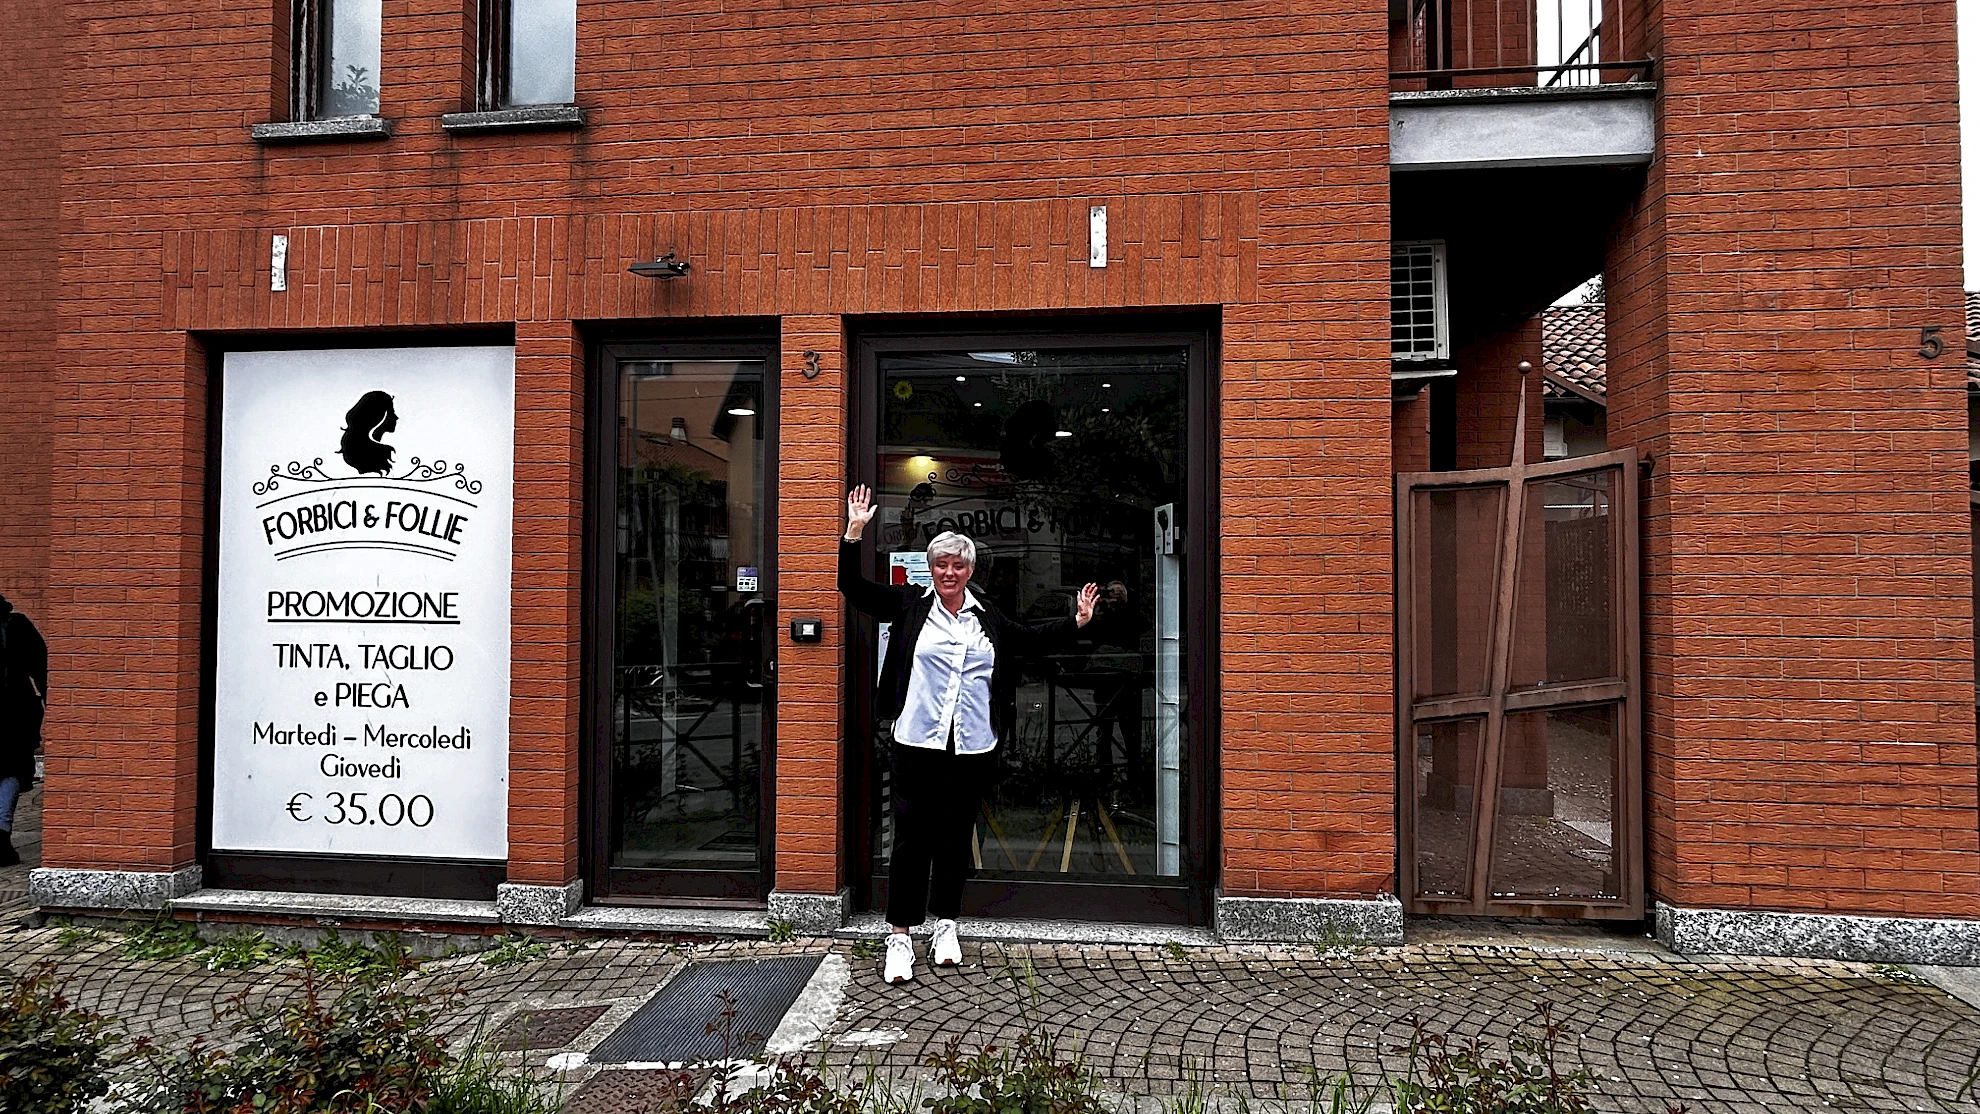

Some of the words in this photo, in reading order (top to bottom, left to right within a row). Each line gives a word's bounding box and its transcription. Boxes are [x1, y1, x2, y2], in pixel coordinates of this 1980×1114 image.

[1918, 325, 1944, 360] 5
[802, 350, 820, 379] 3
[262, 500, 357, 545] FORBICI
[363, 504, 380, 529] &
[385, 501, 469, 545] FOLLIE
[267, 590, 459, 619] PROMOZIONE
[272, 643, 350, 671] TINTA,
[358, 644, 454, 671] TAGLIO
[314, 691, 328, 707] e
[335, 682, 410, 709] PIEGA
[253, 721, 336, 746] Martedì
[364, 723, 471, 750] Mercoledì
[320, 753, 401, 779] Giovedì
[285, 792, 313, 822] €
[324, 791, 434, 828] 35.00
